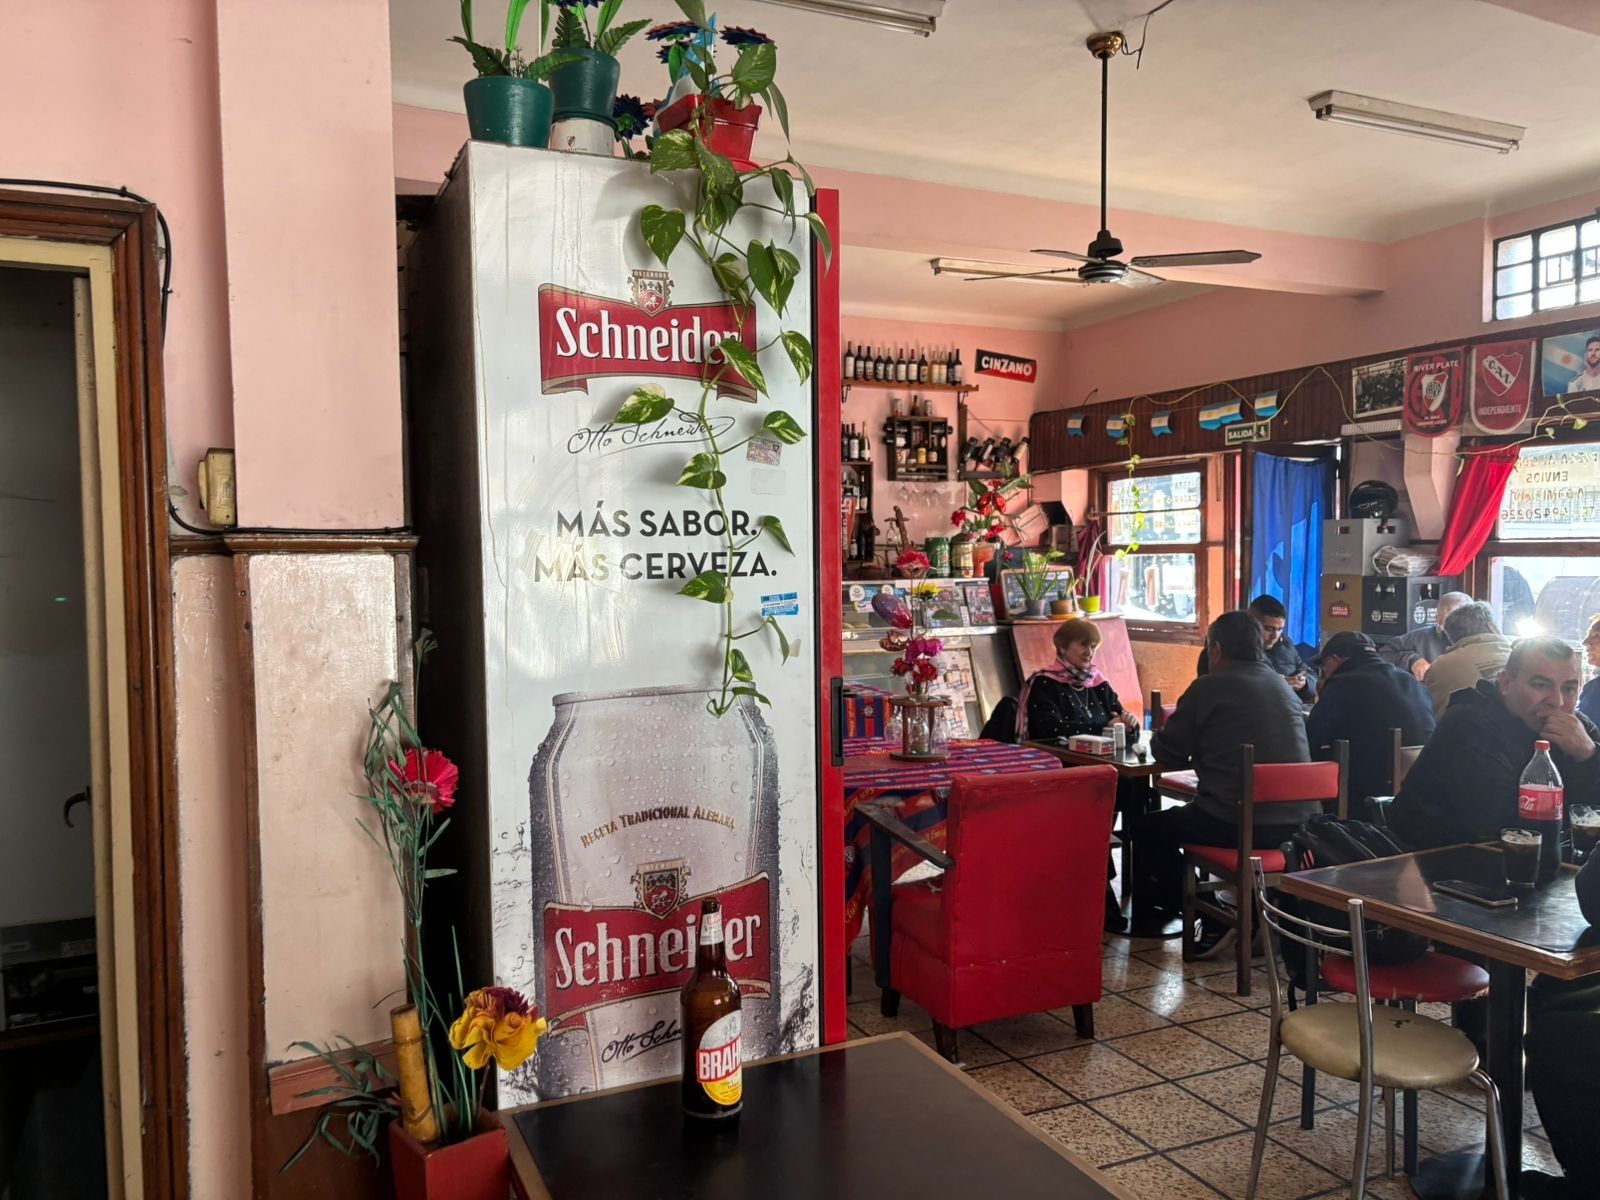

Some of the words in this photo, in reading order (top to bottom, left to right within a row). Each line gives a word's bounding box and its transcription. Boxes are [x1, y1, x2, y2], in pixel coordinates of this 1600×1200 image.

[556, 307, 742, 364] Schneider
[981, 356, 1032, 376] CINZANO
[1413, 362, 1435, 372] RIVER
[1436, 359, 1459, 369] PLATE
[1228, 430, 1253, 440] SALIDA
[556, 500, 631, 538] MÁS
[639, 509, 757, 537] SABOR.
[534, 544, 611, 583] MÁS
[619, 551, 778, 581] CERVEZA.
[580, 820, 618, 848] RECETA
[619, 806, 691, 829] TRADICIONAL
[555, 913, 761, 989] Schneier
[699, 1036, 741, 1081] BRAH
